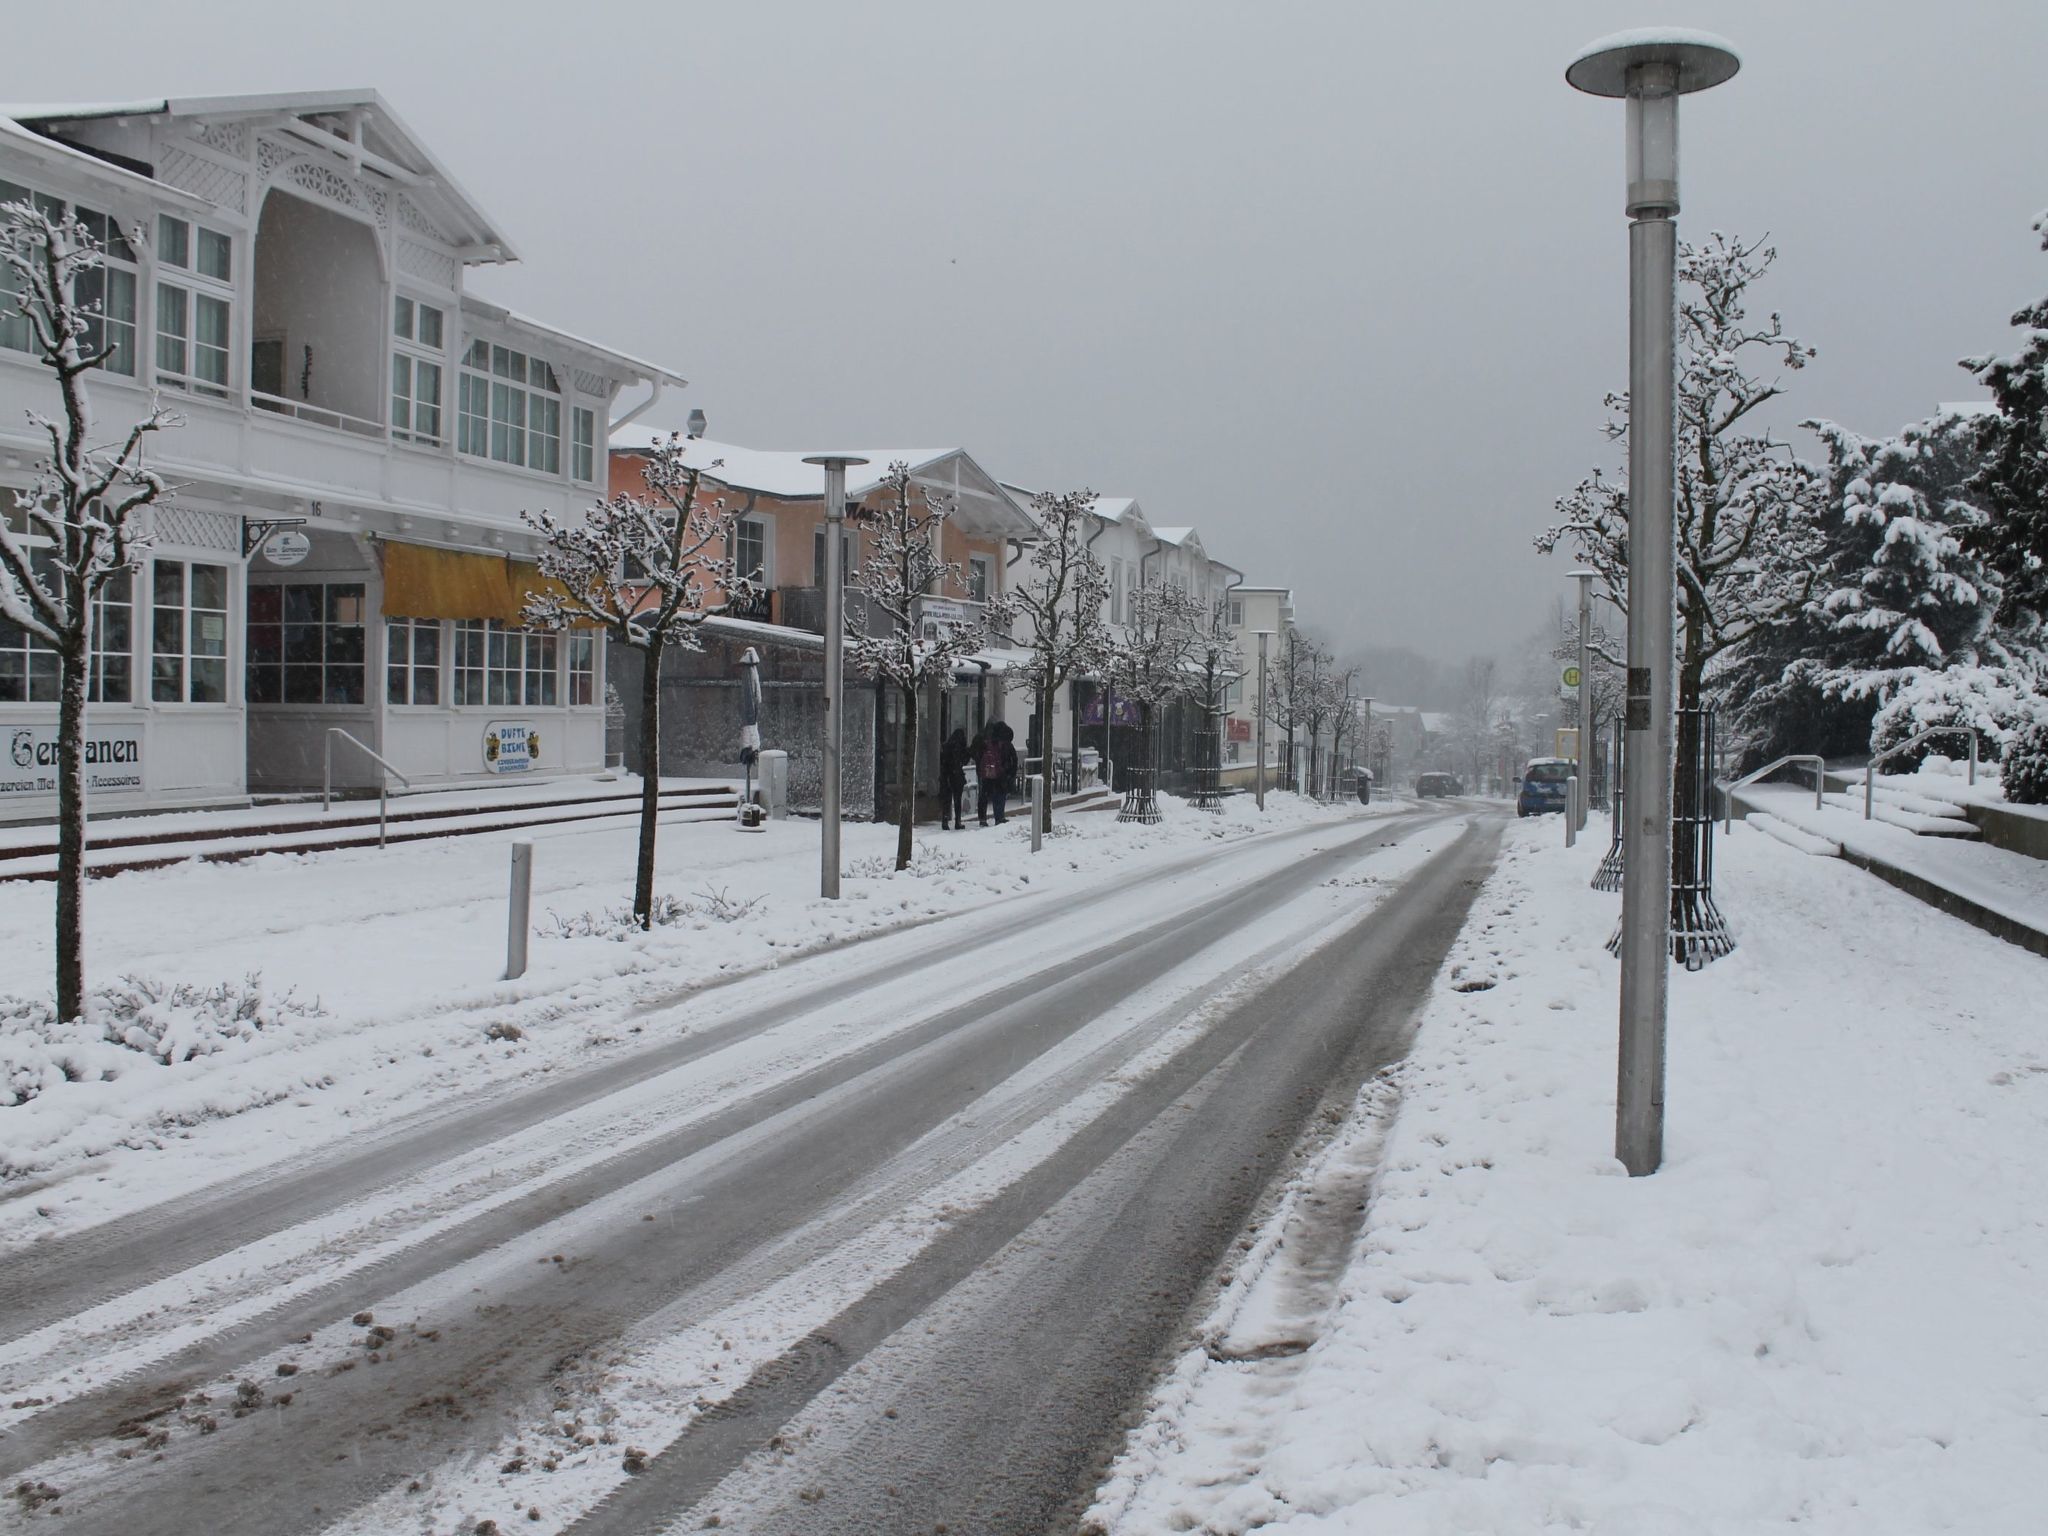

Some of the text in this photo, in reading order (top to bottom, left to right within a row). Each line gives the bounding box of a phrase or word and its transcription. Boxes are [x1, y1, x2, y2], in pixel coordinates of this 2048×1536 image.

[311, 500, 322, 517] 16
[1568, 671, 1578, 683] H
[501, 727, 526, 739] DUFTE
[10, 729, 139, 769] Geranen
[501, 742, 526, 753] BIENE
[91, 775, 141, 788] Accessoires
